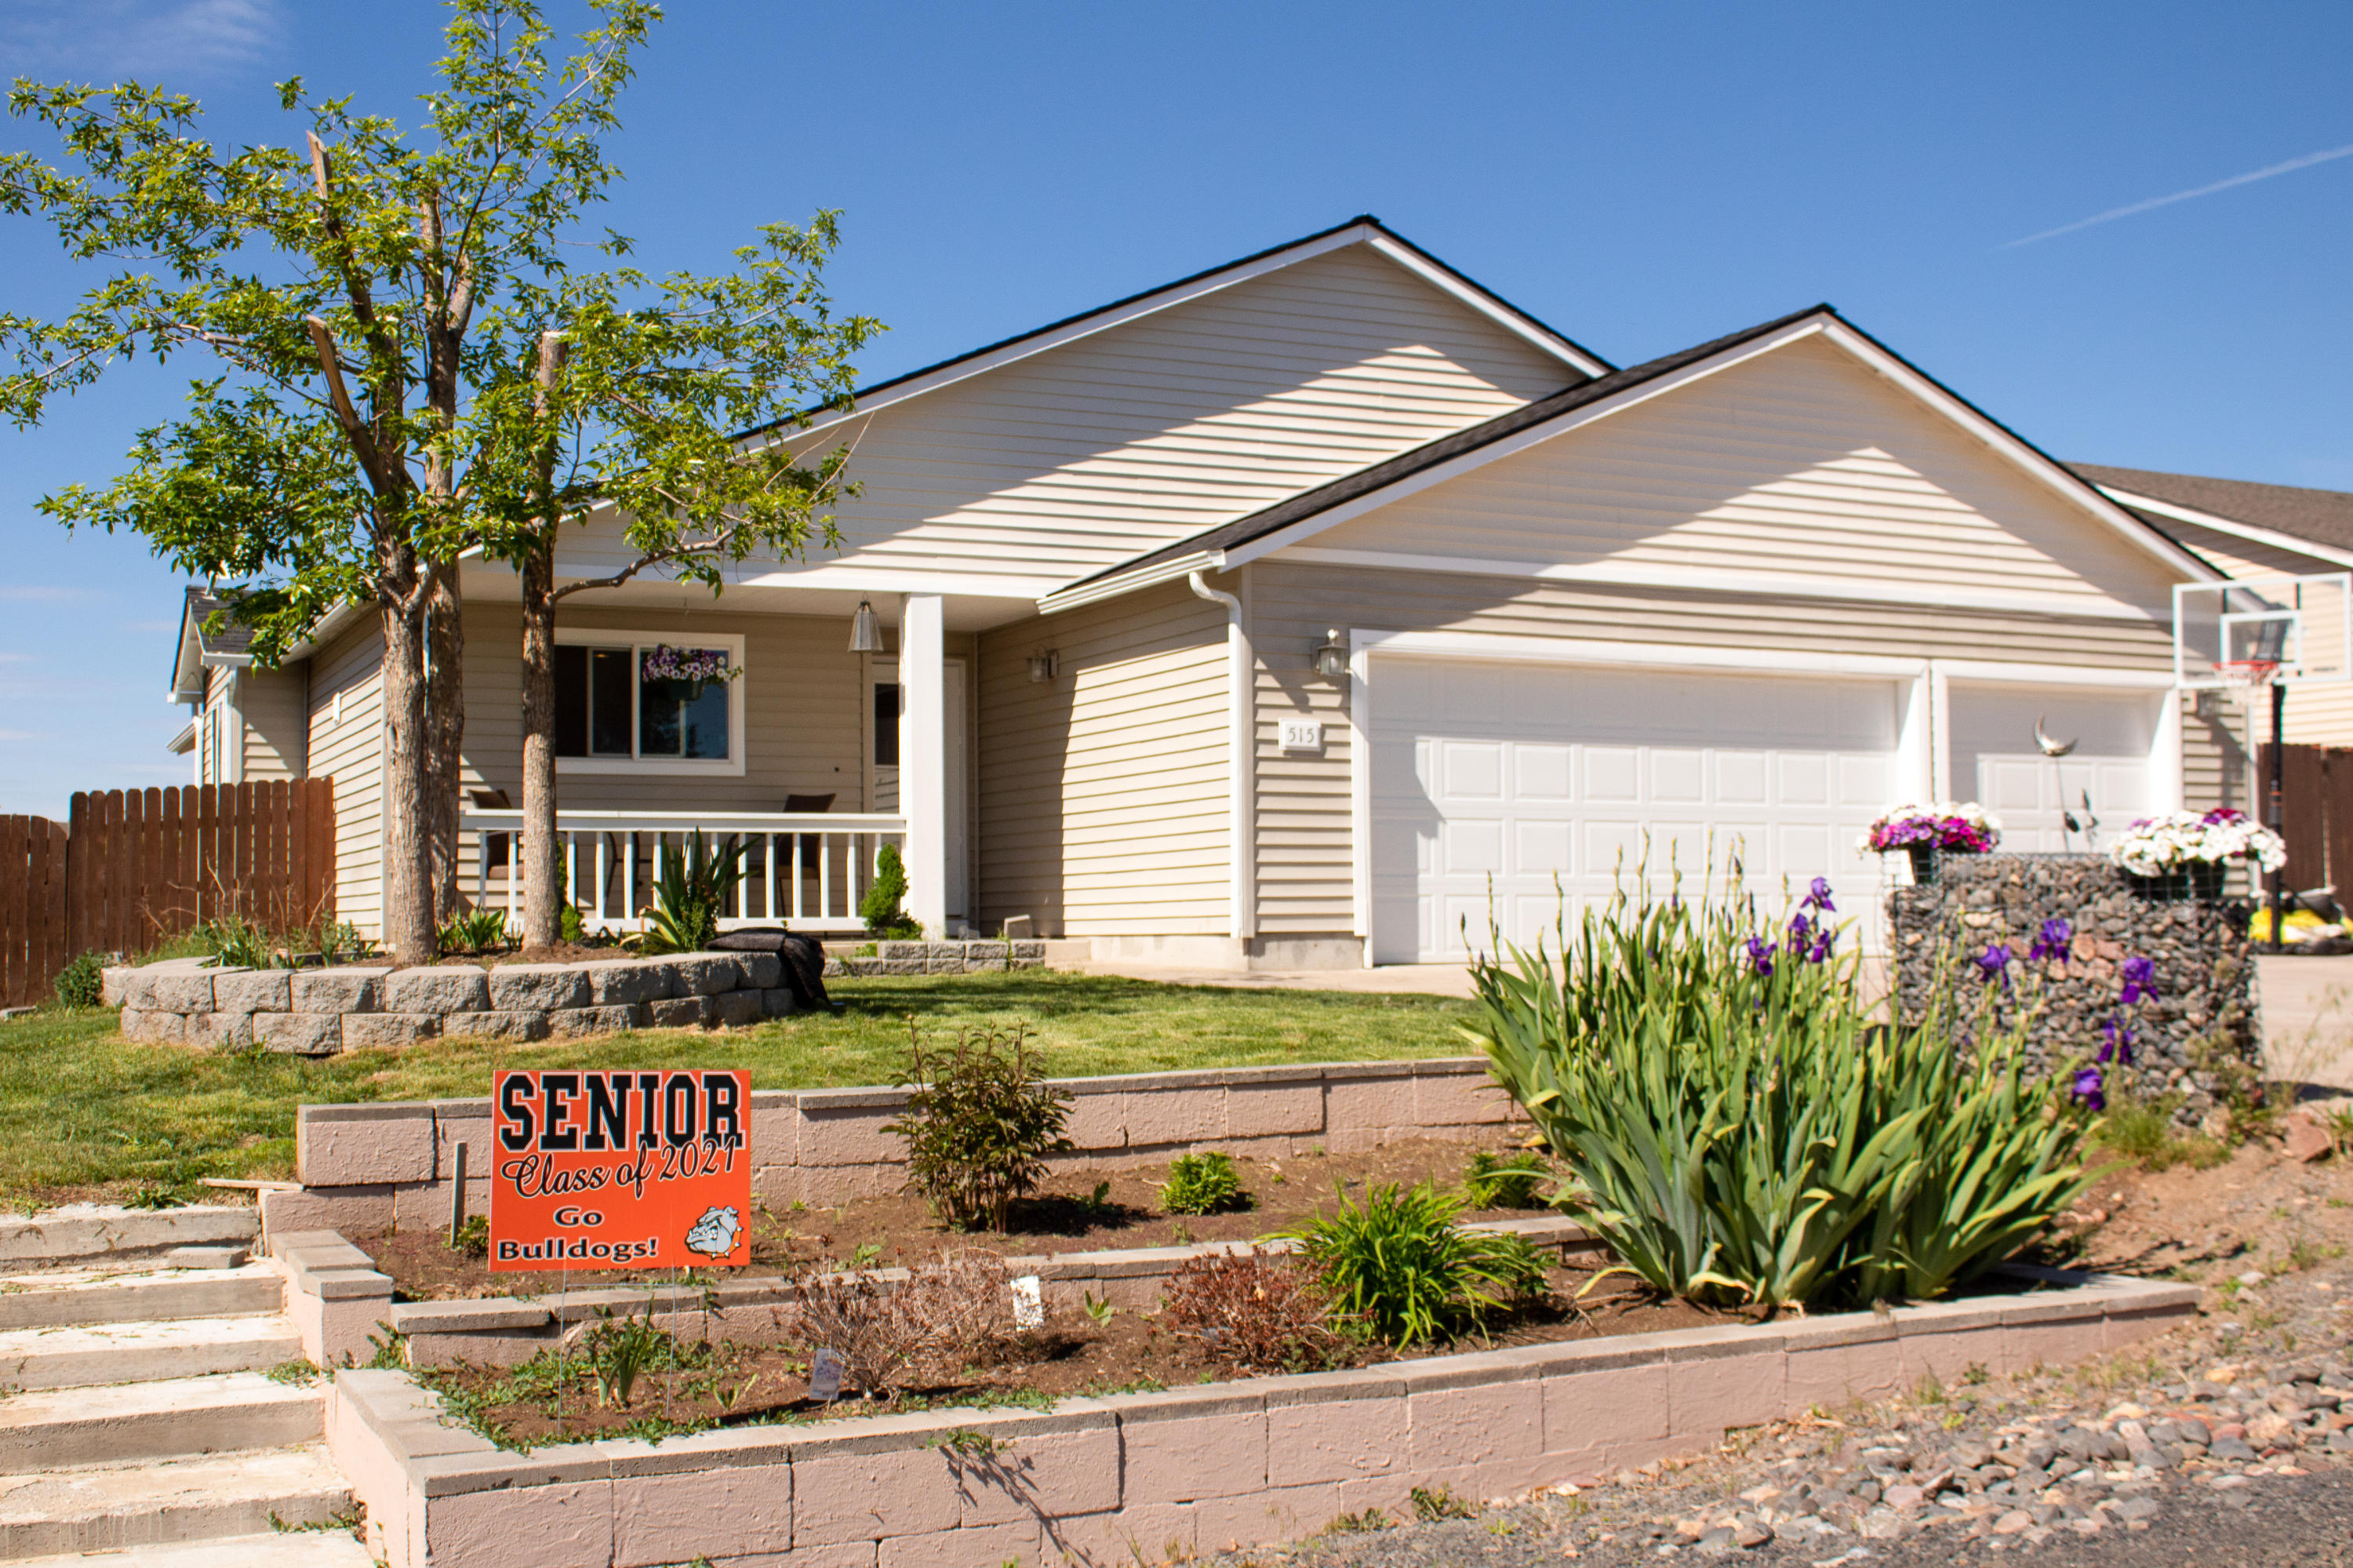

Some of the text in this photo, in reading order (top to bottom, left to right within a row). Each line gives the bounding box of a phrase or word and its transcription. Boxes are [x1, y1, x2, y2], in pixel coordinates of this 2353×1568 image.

[1289, 727, 1315, 743] 515
[499, 1072, 746, 1152] SENIOR
[501, 1137, 736, 1199] Class of 2021
[554, 1206, 604, 1228] Go
[497, 1237, 659, 1264] Bulldogs!
